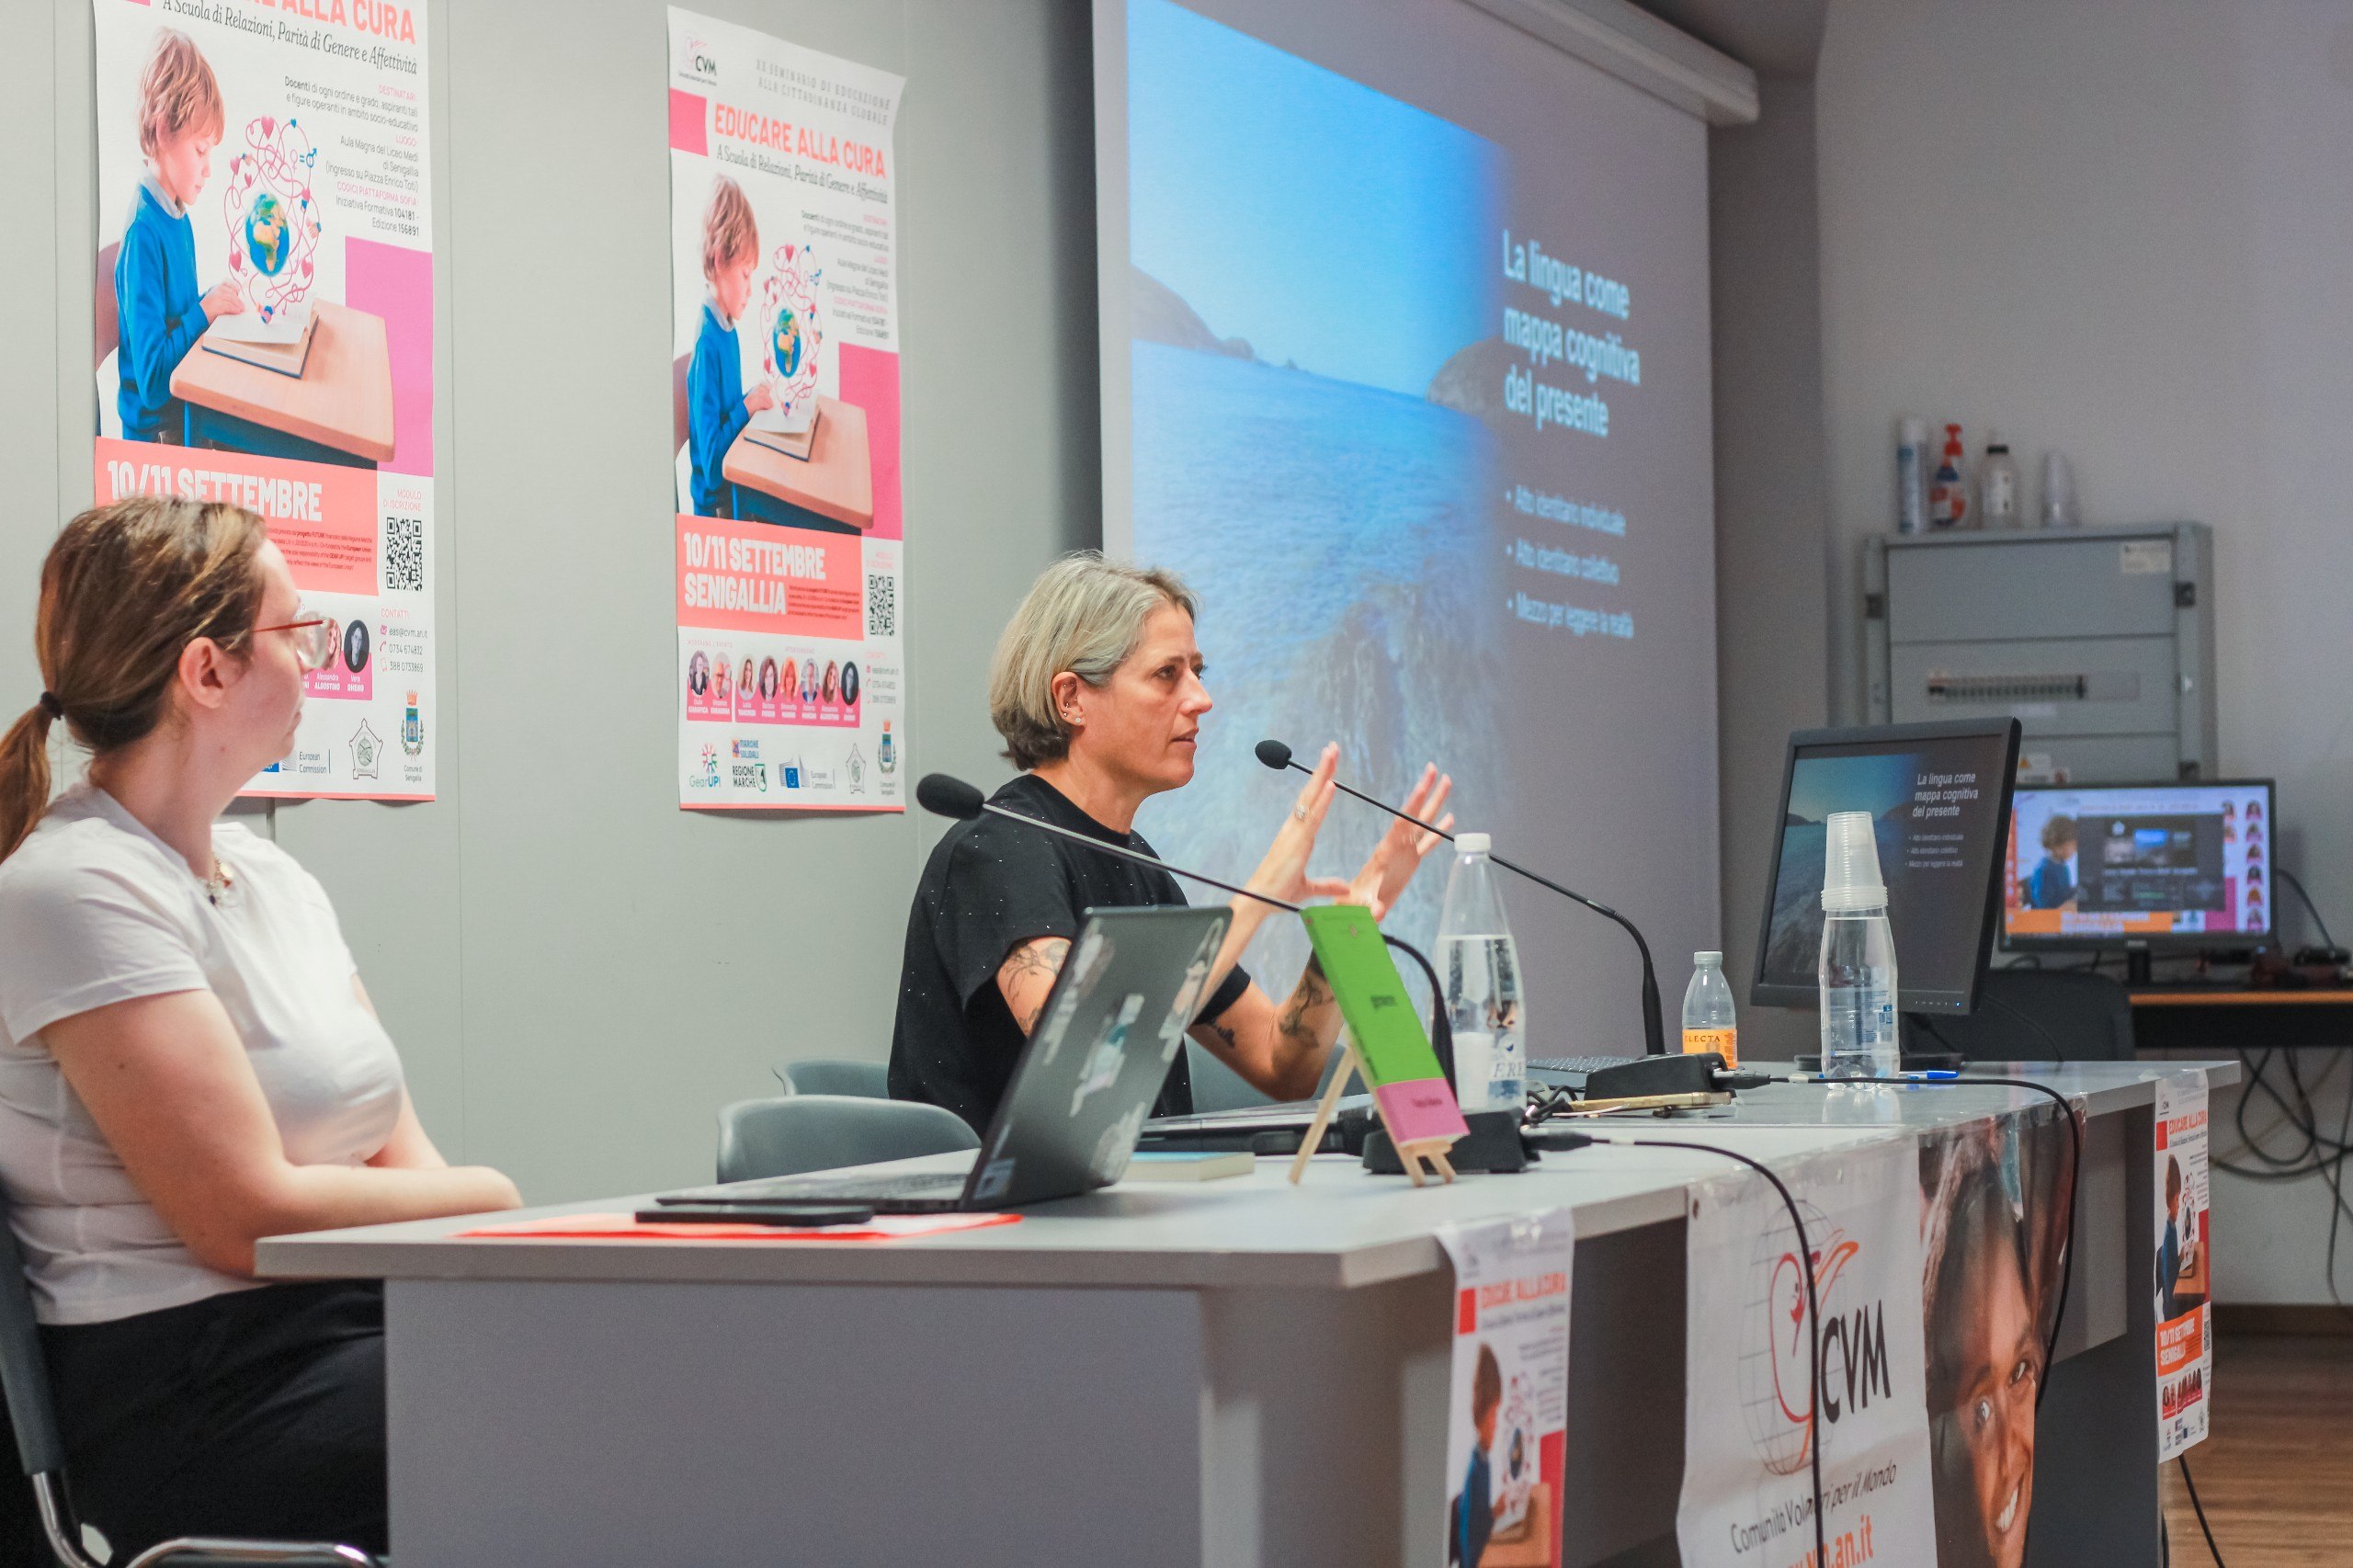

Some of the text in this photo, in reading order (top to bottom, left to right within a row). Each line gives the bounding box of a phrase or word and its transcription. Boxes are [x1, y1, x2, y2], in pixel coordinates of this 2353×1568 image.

[353, 0, 416, 45] CURA
[175, 0, 210, 21] Scuola
[213, 4, 222, 24] di
[225, 7, 275, 42] Relazioni,
[278, 21, 308, 48] Parità
[311, 30, 320, 50] di
[323, 34, 360, 60] Genere
[362, 49, 367, 61] e
[369, 46, 417, 75] Affettività
[696, 55, 717, 76] CVM
[285, 76, 310, 91] Docenti
[311, 84, 318, 93] di
[319, 86, 333, 99] ogni
[335, 90, 354, 103] ordine
[381, 101, 407, 115] aspiranti
[408, 106, 418, 118] tali
[821, 80, 831, 92] DI
[292, 93, 311, 107] figure
[312, 99, 339, 114] operanti
[341, 105, 347, 114] in
[348, 107, 369, 120] ambito
[370, 112, 418, 132] socio-educativo
[340, 135, 354, 148] Aula
[355, 139, 375, 153] Magna
[377, 145, 385, 155] del
[387, 147, 402, 158] Liceo
[714, 102, 886, 179] EDUCARE ALLA CURA
[356, 170, 363, 179] su
[364, 170, 384, 184] Piazza
[336, 195, 364, 210] Iniziativa
[364, 201, 393, 217] Formativa
[1503, 229, 1630, 320] La lingua come
[1504, 306, 1640, 386] mappa cognitiva
[1504, 364, 1609, 437] del presente
[108, 460, 322, 522] 10/11 SETTEMBRE
[683, 532, 727, 570] 10/11
[729, 537, 826, 581] SETTEMBRE
[684, 572, 786, 615] SENIGALLIA
[381, 608, 409, 619] CONTATTI
[389, 661, 400, 670] 388
[299, 751, 320, 761] European
[299, 765, 327, 774] Commission
[732, 765, 754, 776] REGIONE
[1917, 773, 1976, 787] La lingua come
[733, 777, 756, 787] MARCHE
[1915, 788, 1978, 803] mappa cognitiva
[1912, 805, 1960, 820] del presente
[1821, 1298, 1892, 1423] CVM
[1831, 1482, 1852, 1513] per
[1852, 1471, 1861, 1498] il
[1863, 1459, 1897, 1495] Mondo
